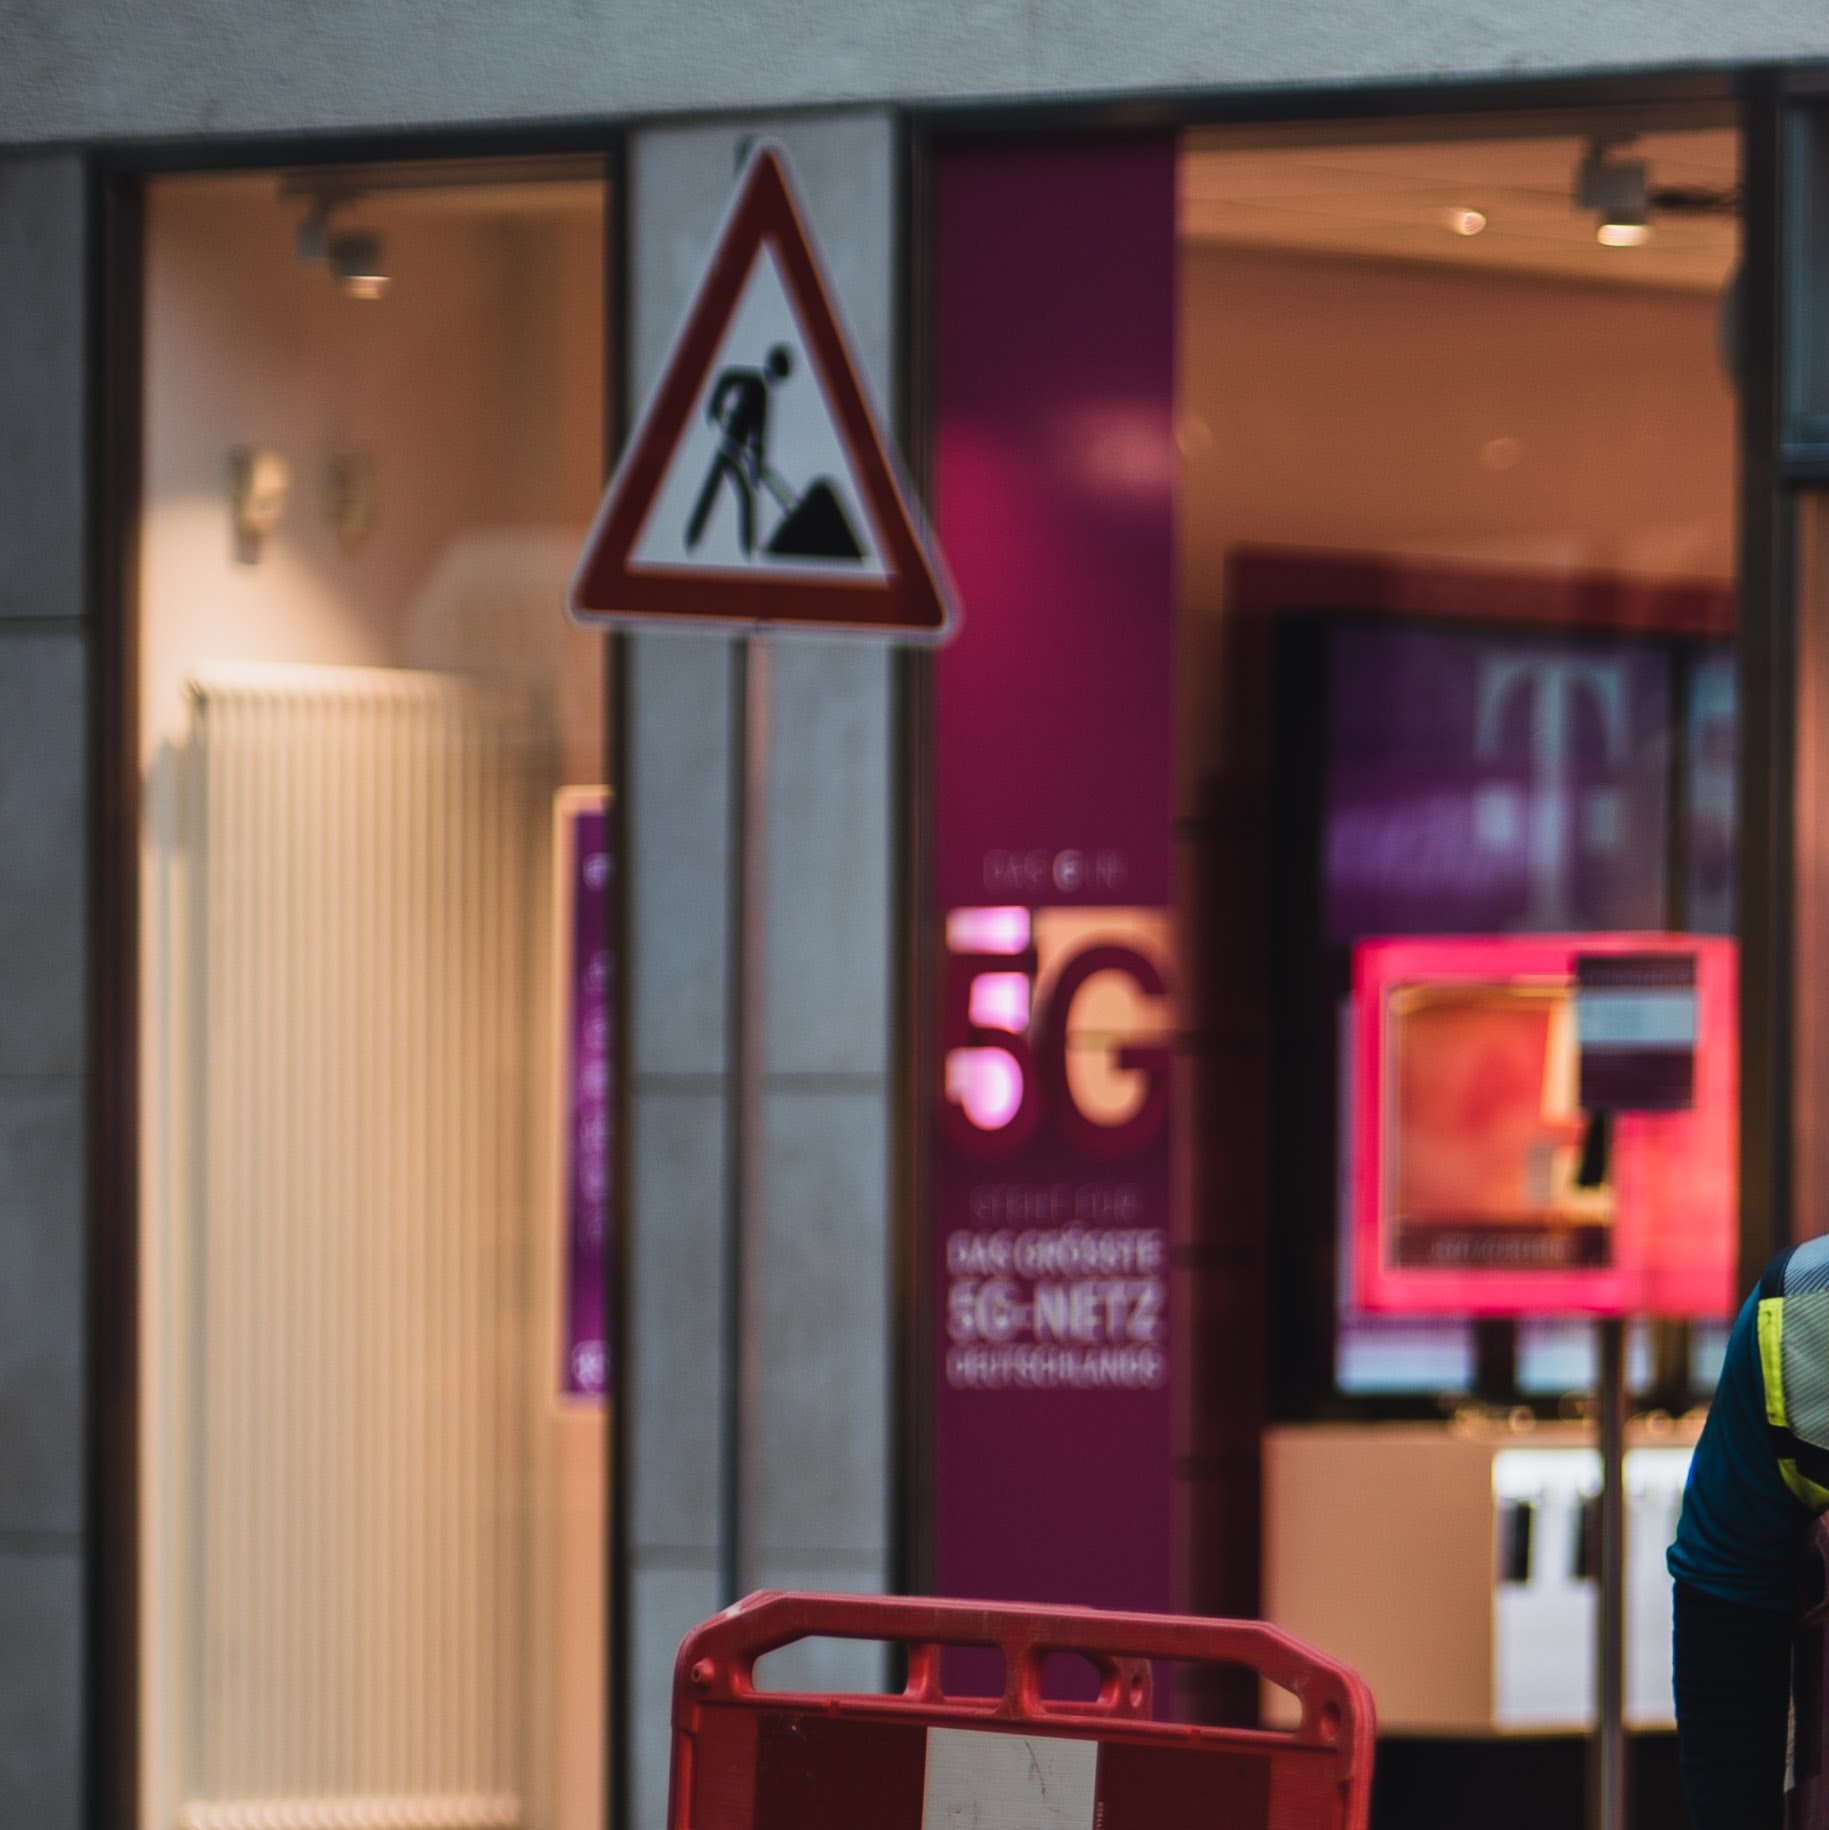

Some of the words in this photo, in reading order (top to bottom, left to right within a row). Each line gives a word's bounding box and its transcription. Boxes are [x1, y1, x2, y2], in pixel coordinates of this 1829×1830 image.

[944, 938, 1176, 1156] 5G
[946, 1228, 1013, 1277] DAS
[1014, 1222, 1165, 1277] GRÖSSTE
[946, 1277, 1166, 1343] 5G-NETZ
[946, 1344, 1167, 1389] DEUTSCHLANDS
